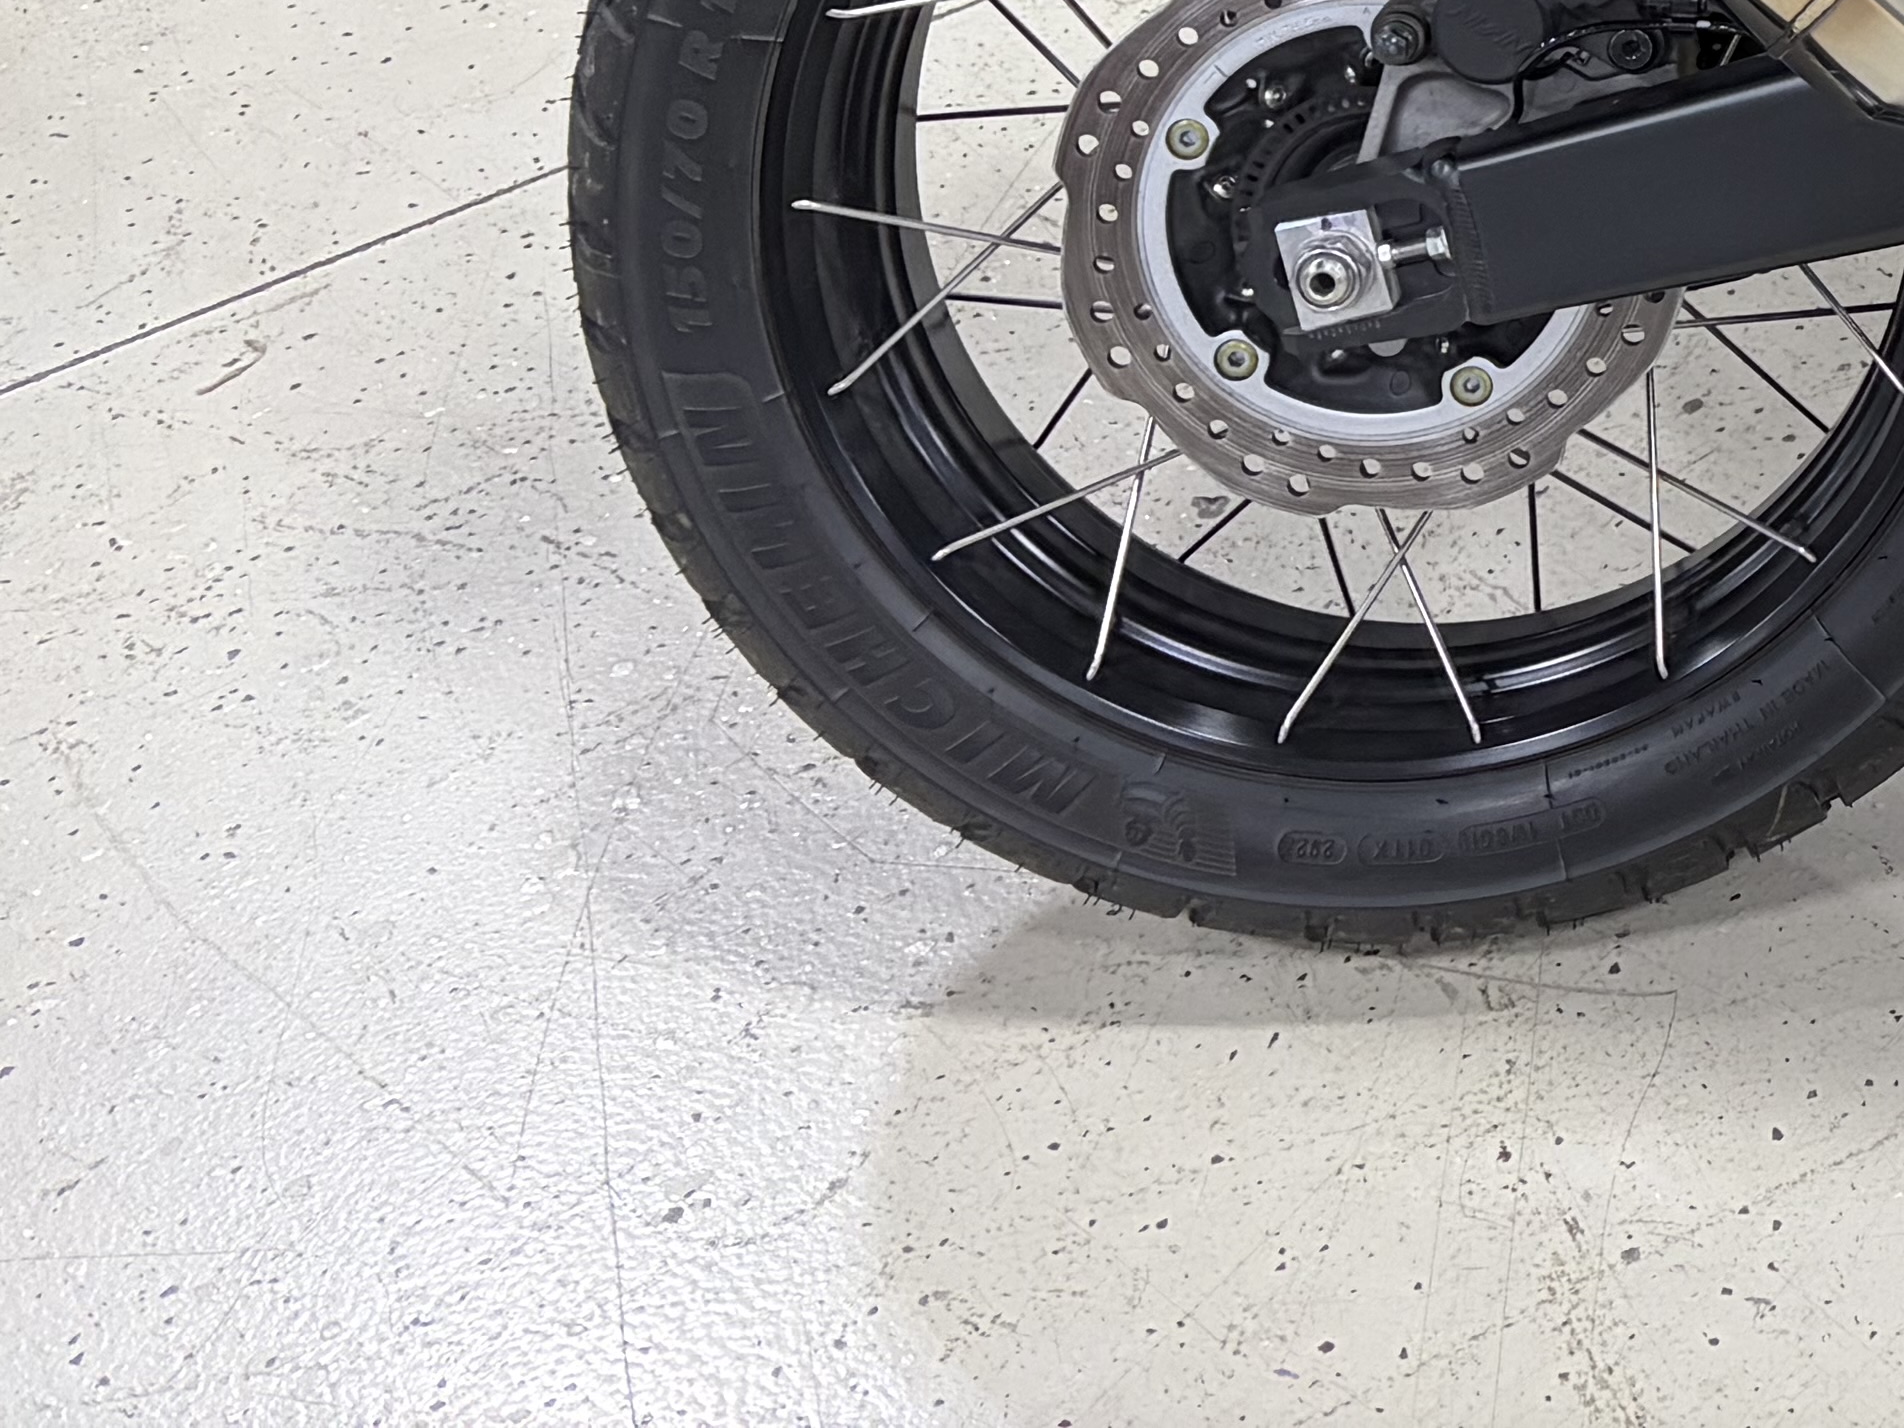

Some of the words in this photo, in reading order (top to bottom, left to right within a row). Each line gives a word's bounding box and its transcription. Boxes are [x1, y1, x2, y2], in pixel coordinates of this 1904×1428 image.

[674, 25, 728, 80] R
[657, 93, 715, 336] 150/70
[682, 393, 1098, 828] MICHELIN
